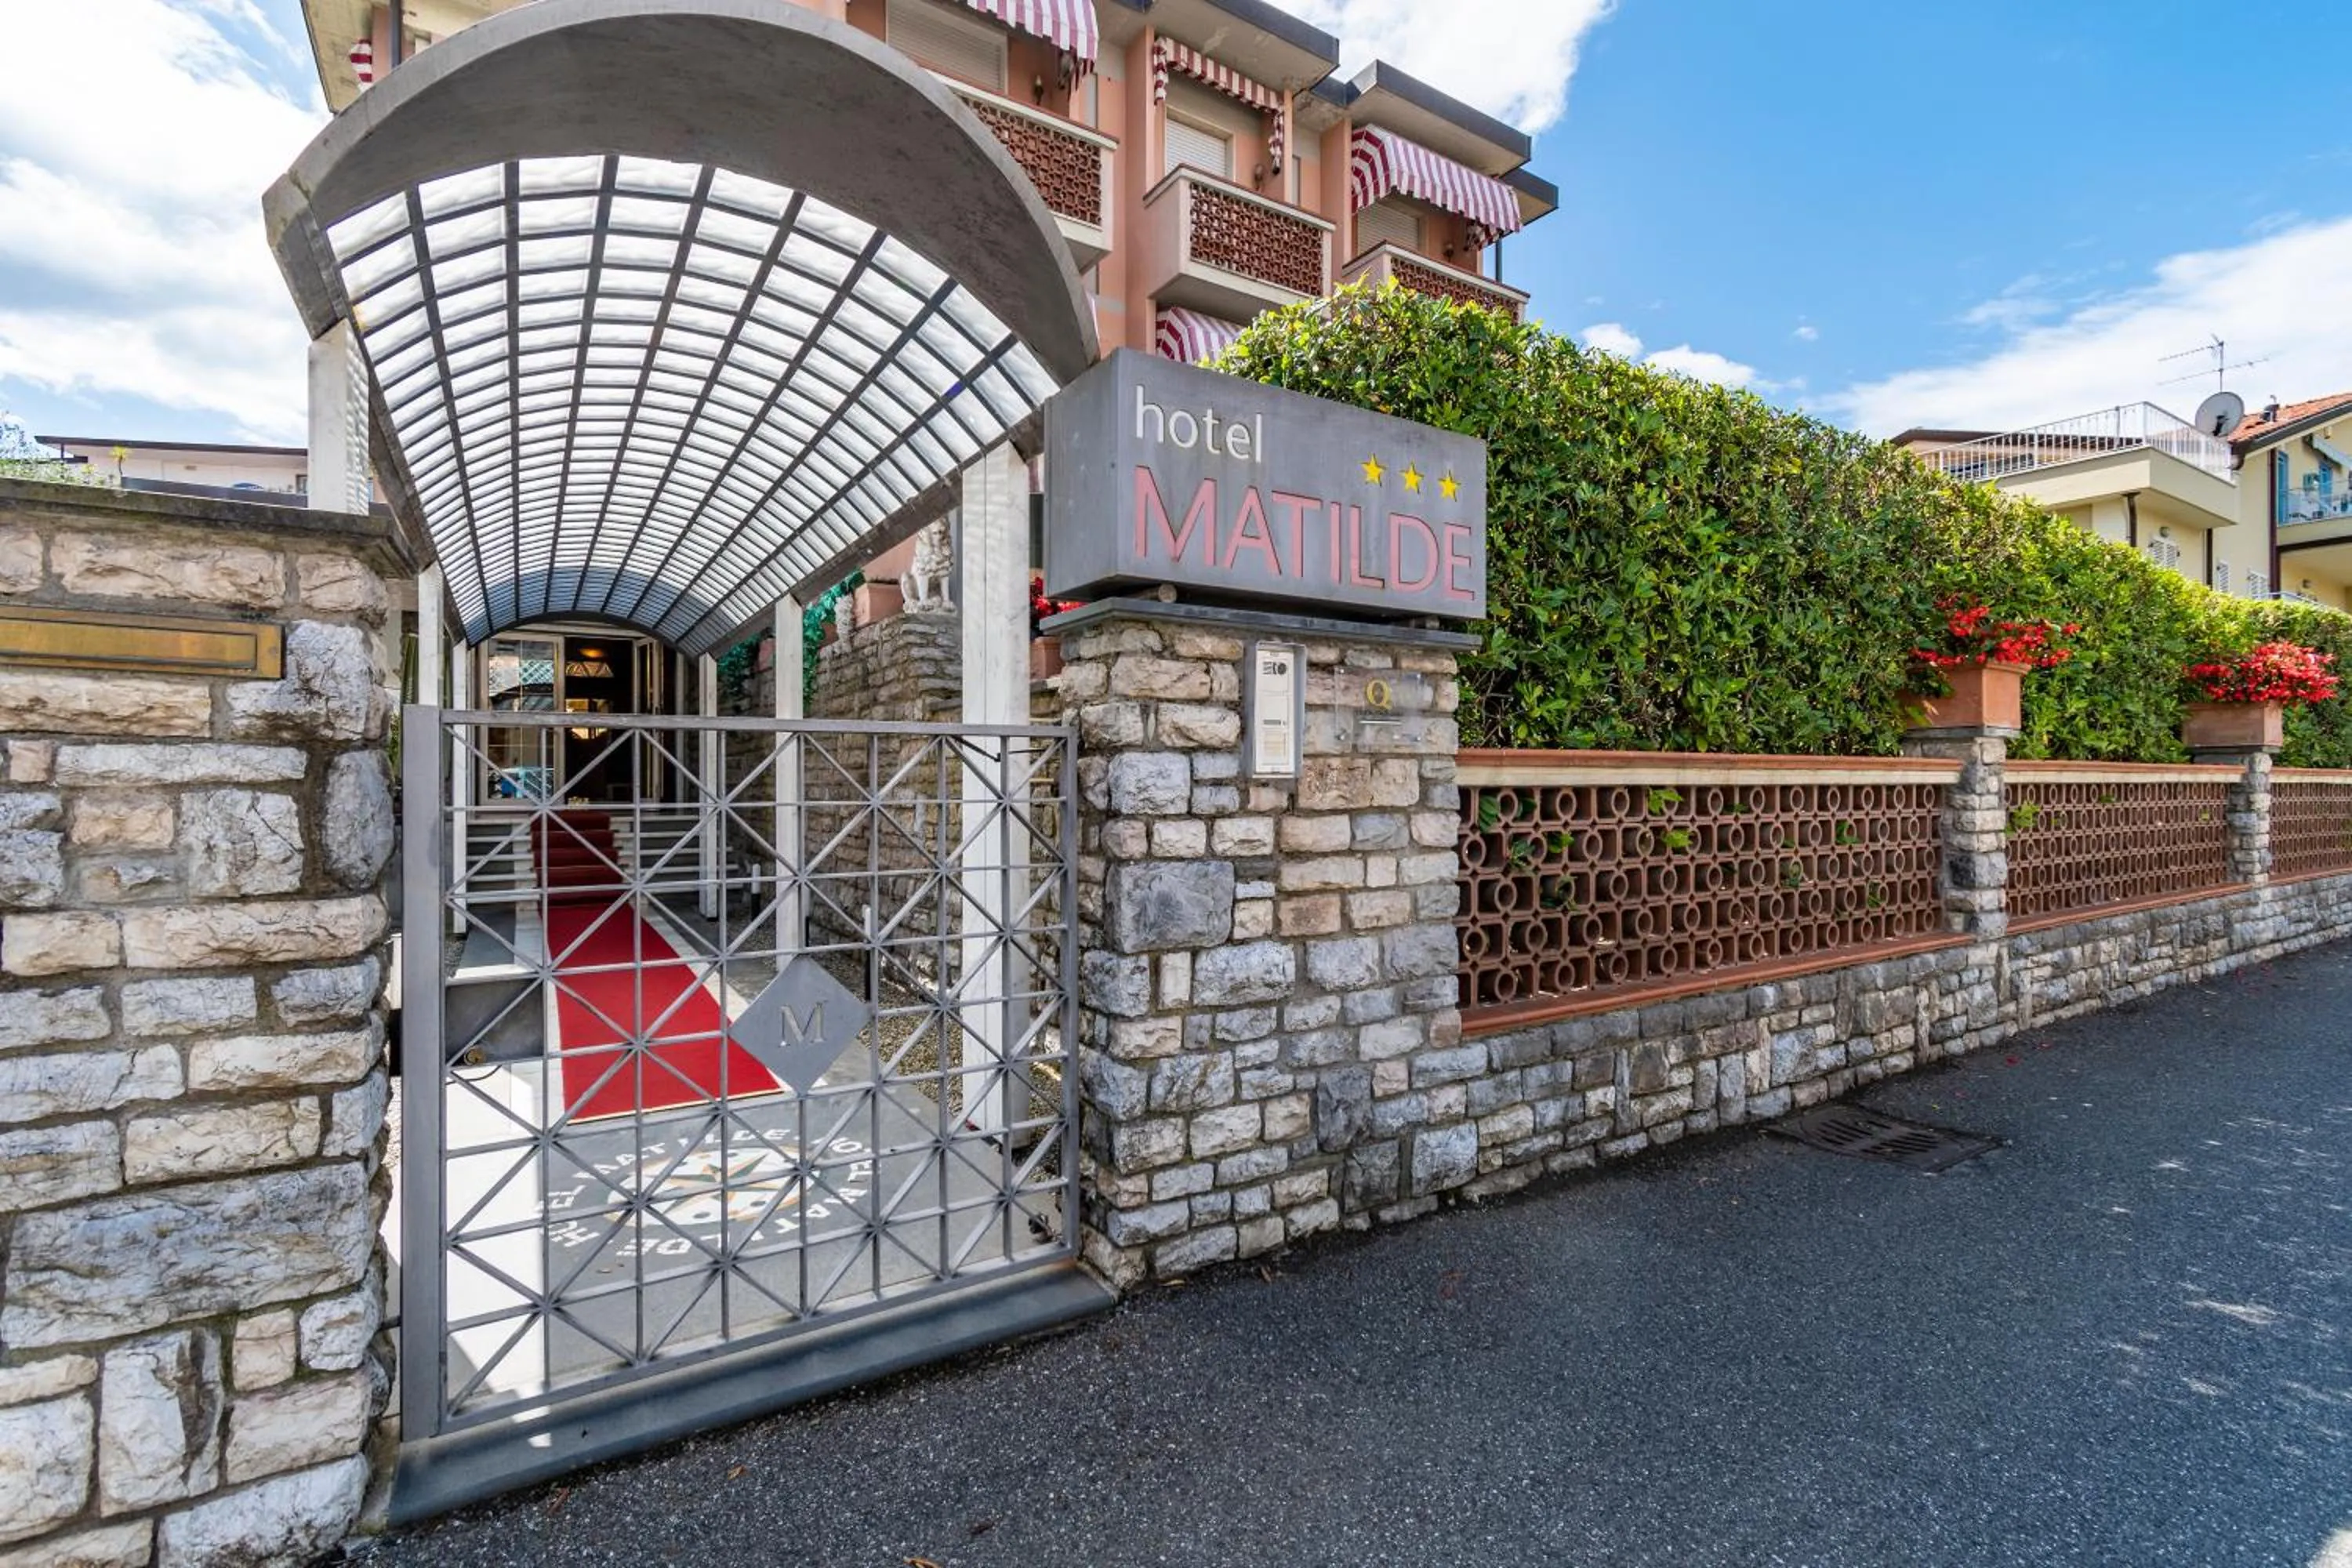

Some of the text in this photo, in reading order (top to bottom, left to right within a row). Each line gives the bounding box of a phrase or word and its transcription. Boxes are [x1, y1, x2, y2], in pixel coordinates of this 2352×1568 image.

[1135, 385, 1262, 463] hotel
[1134, 464, 1475, 601] MATILDE
[779, 999, 829, 1049] M
